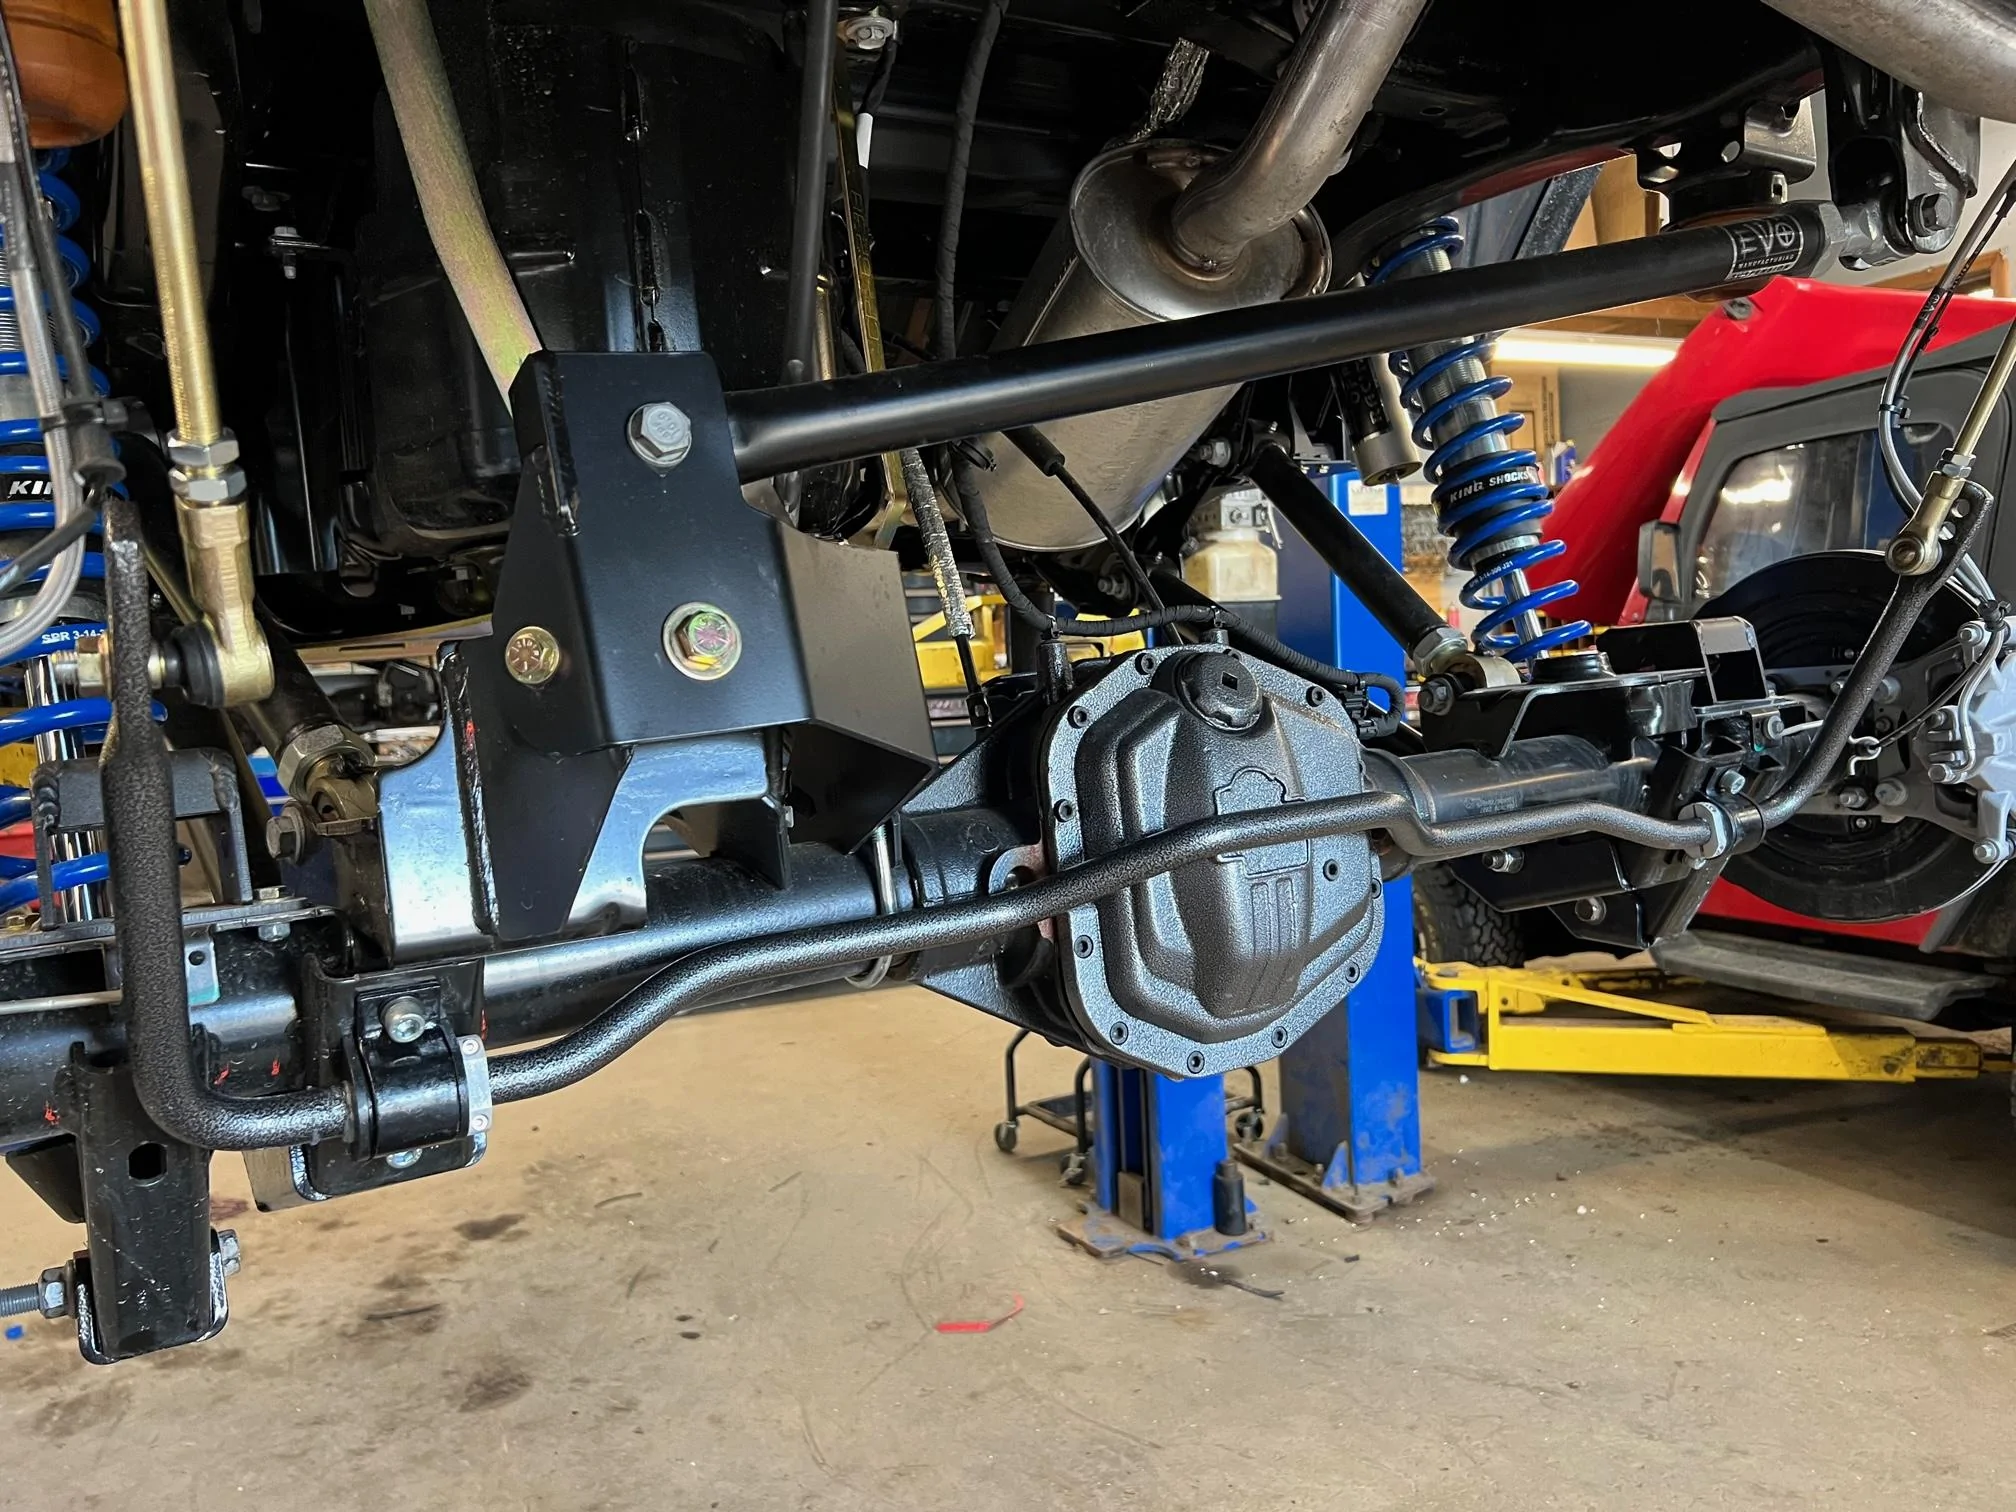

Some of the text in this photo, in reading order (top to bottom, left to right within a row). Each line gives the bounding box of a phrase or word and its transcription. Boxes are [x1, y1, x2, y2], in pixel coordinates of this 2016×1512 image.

[1734, 219, 1796, 260] EVO
[1738, 254, 1795, 269] MANUFACTURING
[1450, 471, 1529, 503] KING SHOCKS
